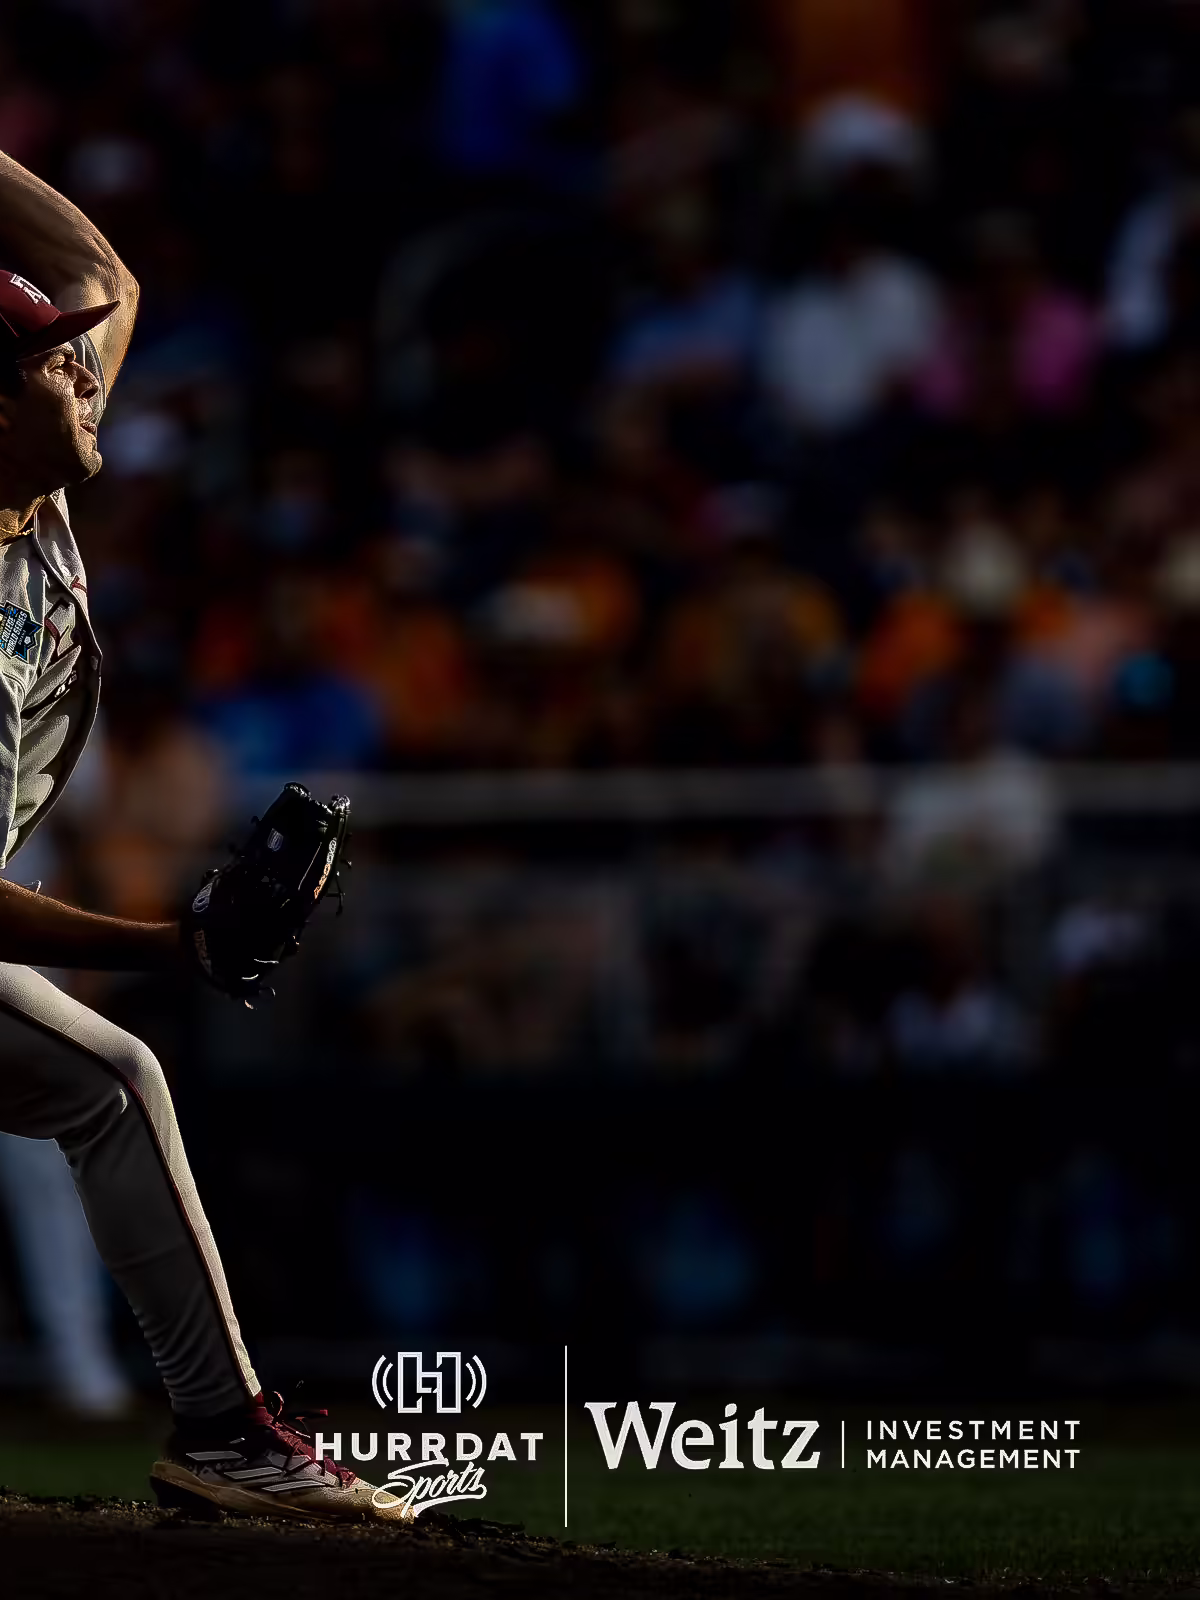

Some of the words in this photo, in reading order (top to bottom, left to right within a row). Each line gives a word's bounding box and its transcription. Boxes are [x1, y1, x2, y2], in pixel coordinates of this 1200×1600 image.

[1, 615, 15, 643] COLLEGE
[12, 610, 28, 636] SERIES
[6, 632, 19, 655] WORLD
